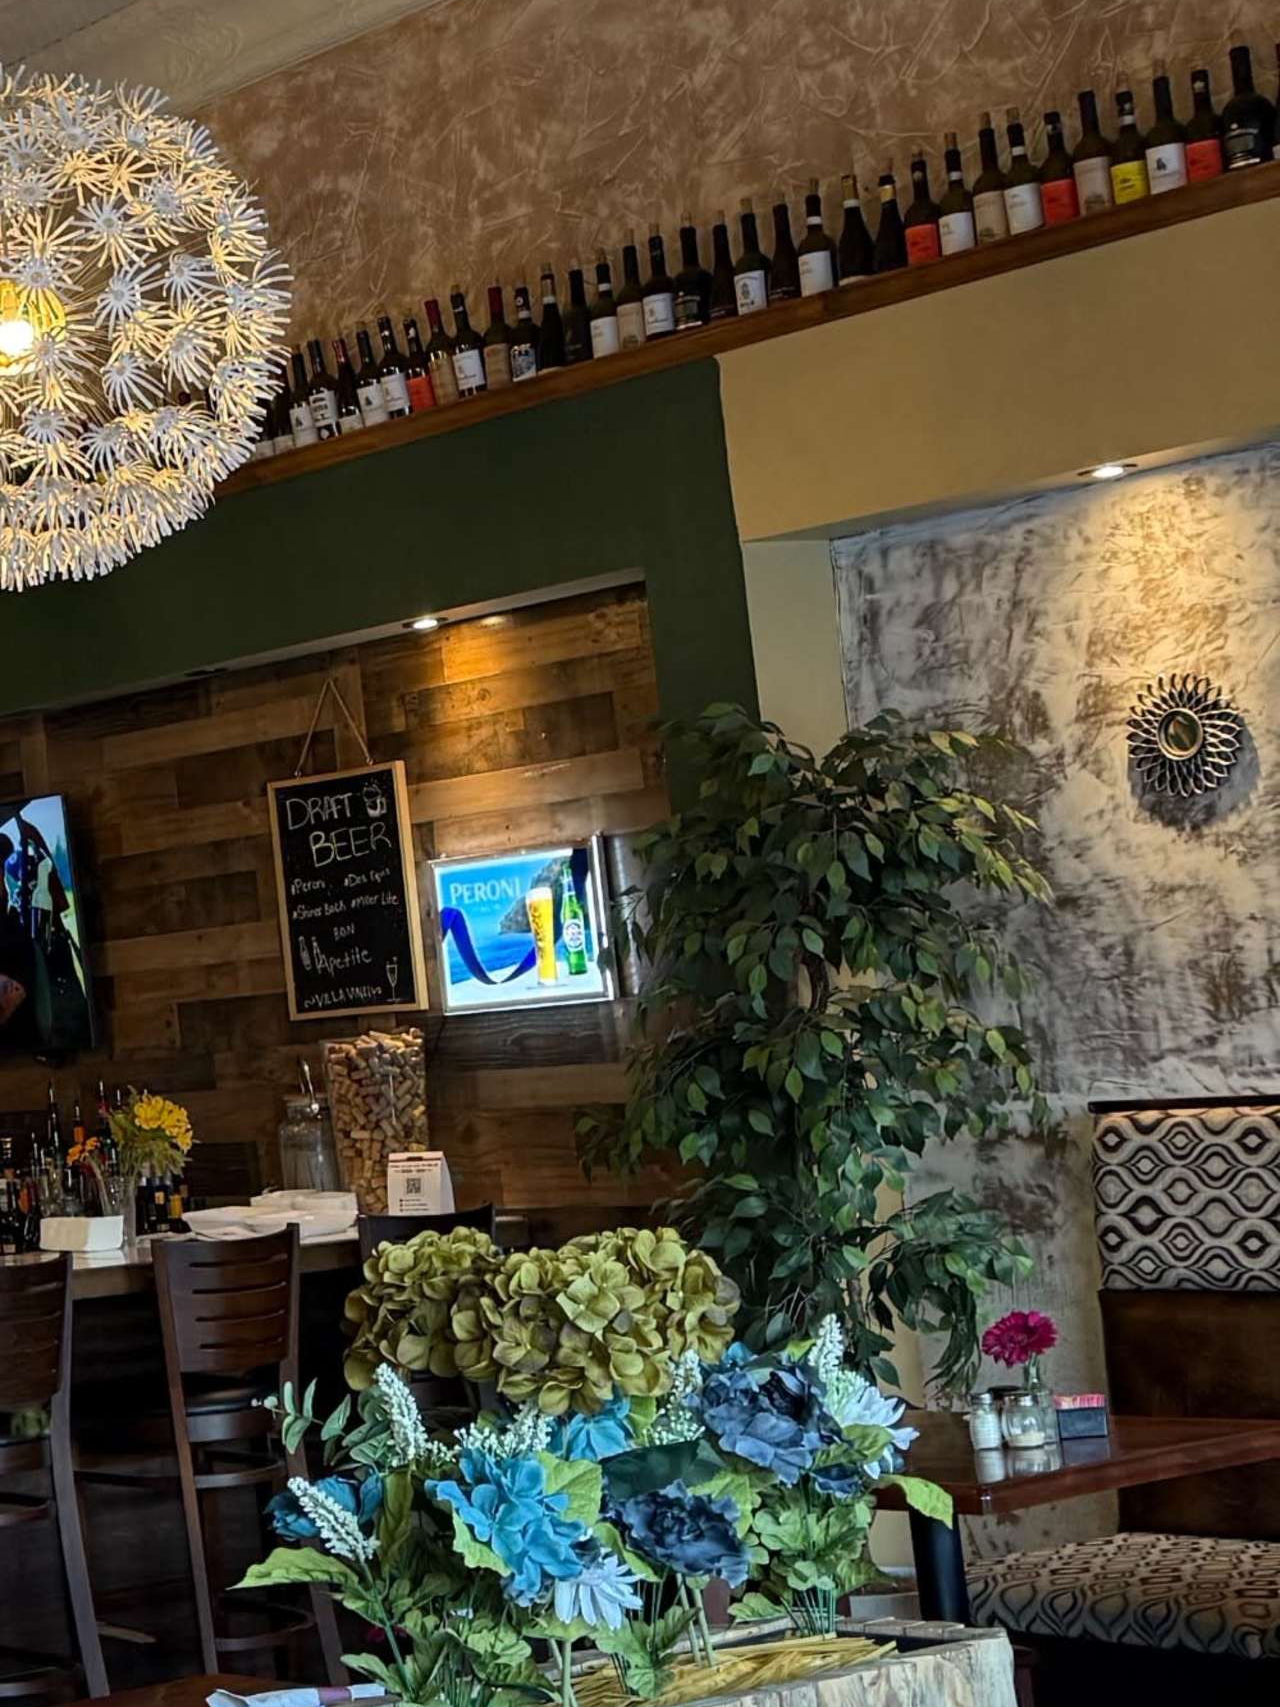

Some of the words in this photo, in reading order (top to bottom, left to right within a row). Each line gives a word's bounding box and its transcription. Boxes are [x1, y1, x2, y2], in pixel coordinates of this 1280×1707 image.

[286, 792, 353, 831] DRAFT
[308, 822, 392, 868] BEER
[450, 877, 521, 905] PERONI
